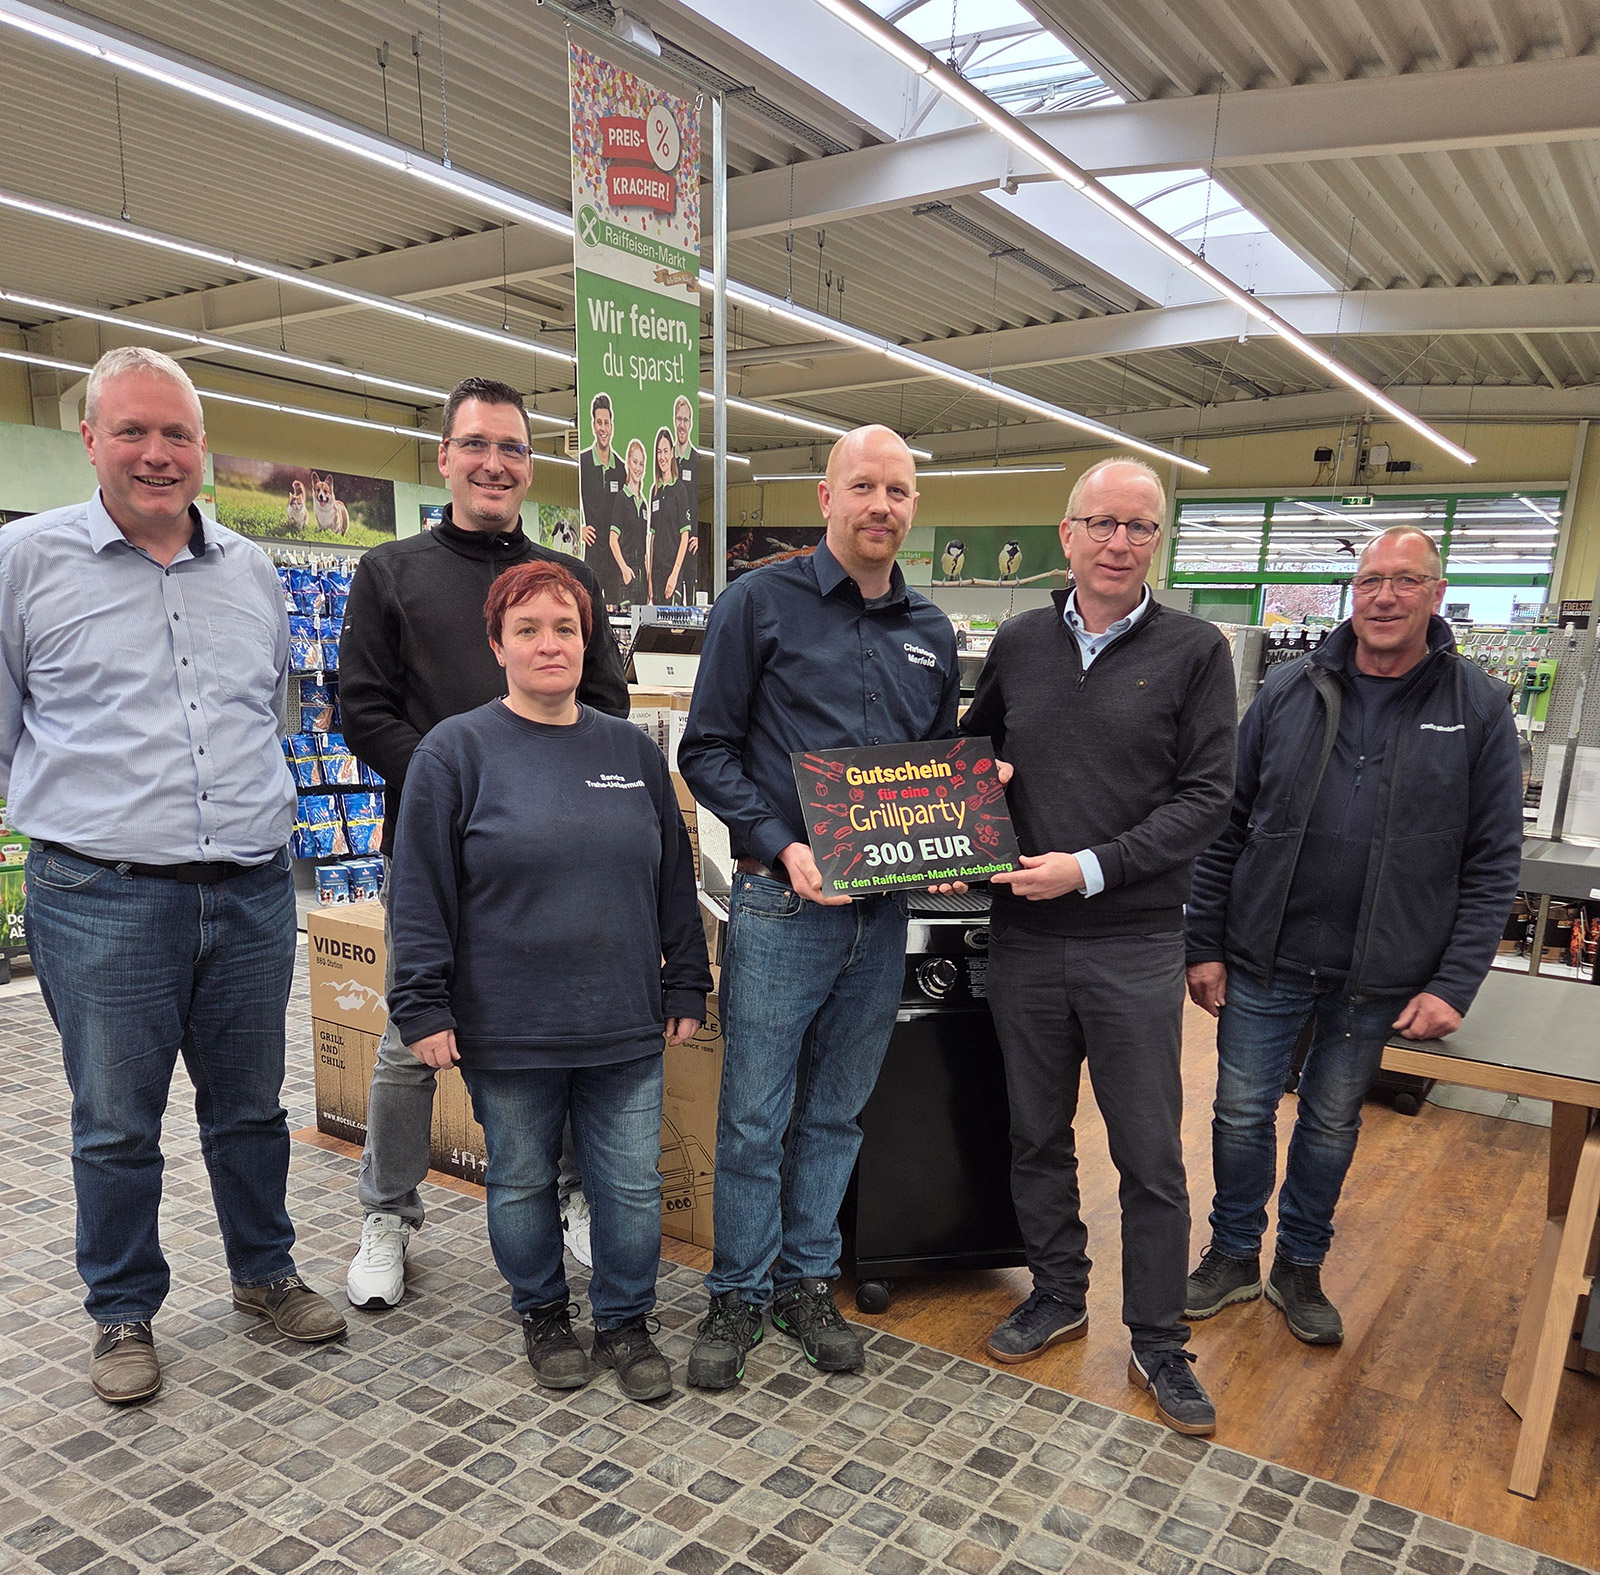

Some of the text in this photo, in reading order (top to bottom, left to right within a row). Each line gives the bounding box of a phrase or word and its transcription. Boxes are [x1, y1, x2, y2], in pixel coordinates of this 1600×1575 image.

[608, 127, 645, 148] PREIS-
[613, 177, 670, 202] KRACHER!
[605, 226, 686, 270] Raiffeisen-Markt
[587, 297, 693, 352] Wir feiern,
[603, 342, 685, 391] du sparst!
[846, 758, 952, 786] Gutschein
[877, 786, 930, 801] für eine
[849, 798, 966, 836] Grillparty
[863, 835, 974, 867] 300 EUR
[833, 862, 1013, 890] für den Raiffeisen-Markt Ascheberg
[313, 935, 376, 965] VIDERO
[320, 1030, 345, 1046] GRILL
[320, 1043, 338, 1055] AND
[320, 1054, 346, 1070] CHILL
